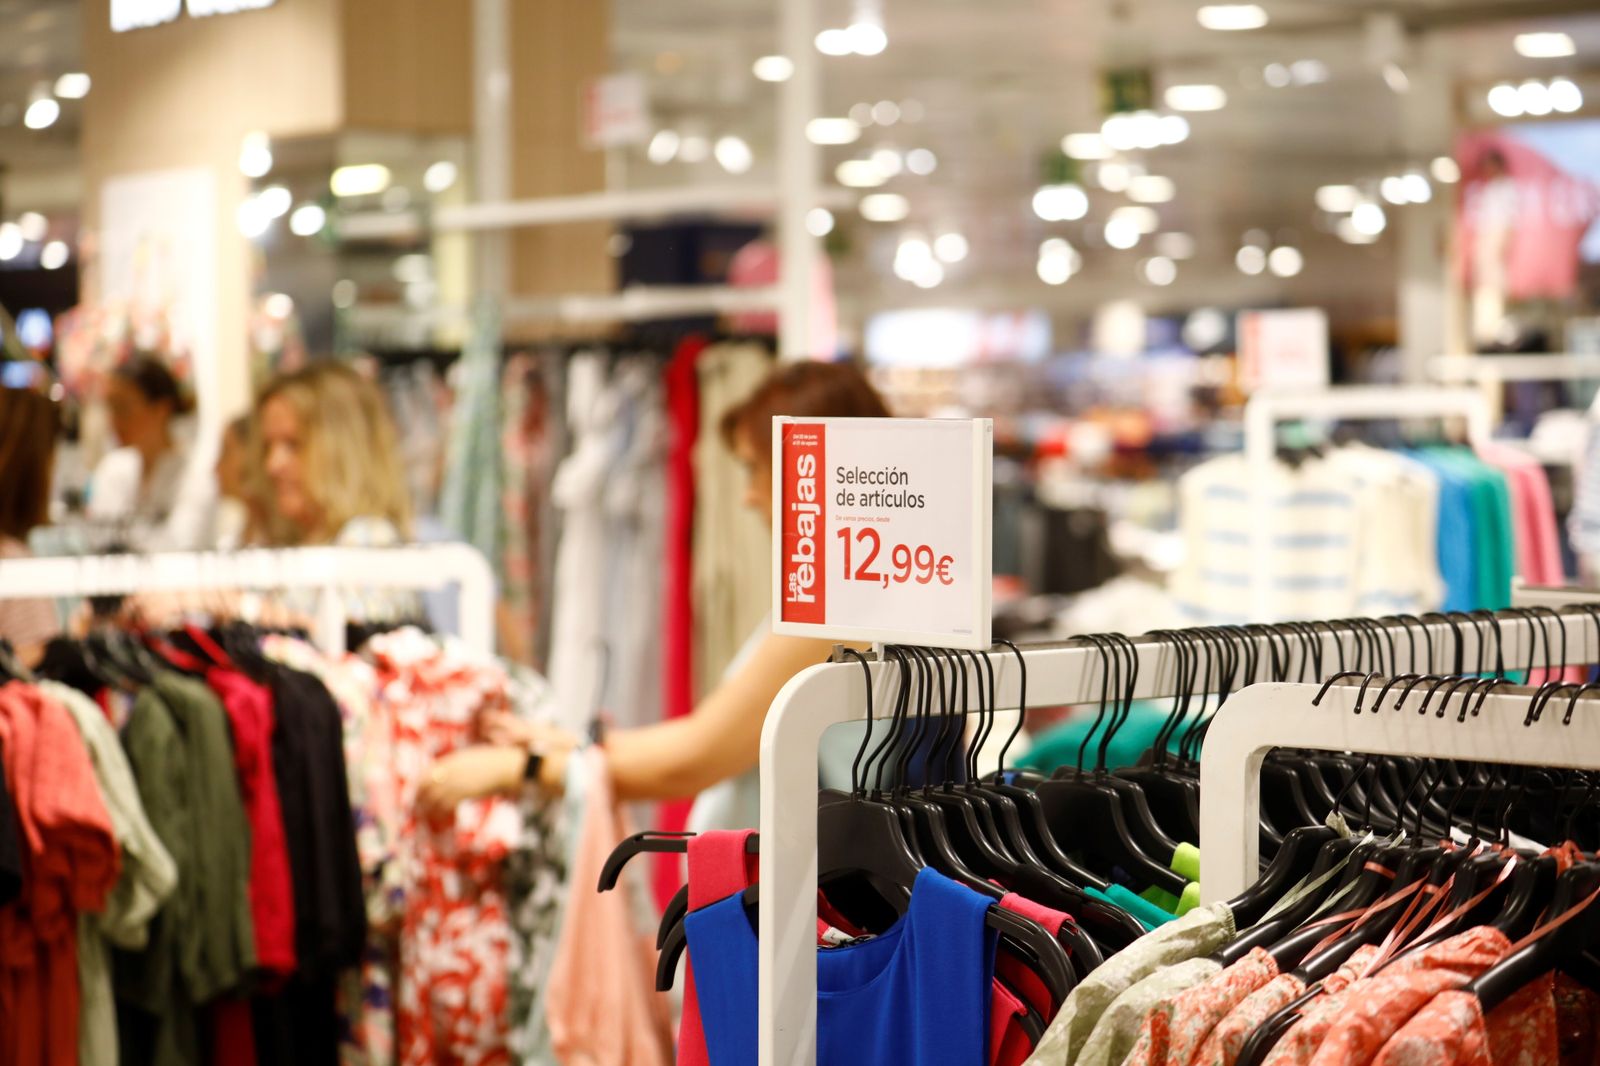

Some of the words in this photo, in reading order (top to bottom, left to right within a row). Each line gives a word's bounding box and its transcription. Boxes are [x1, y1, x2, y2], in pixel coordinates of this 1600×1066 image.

[837, 466, 909, 485] Selección
[836, 488, 855, 507] de
[860, 489, 925, 508] artículos
[791, 453, 821, 603] rebajas
[837, 527, 954, 589] 12,99€
[787, 572, 797, 602] Las
